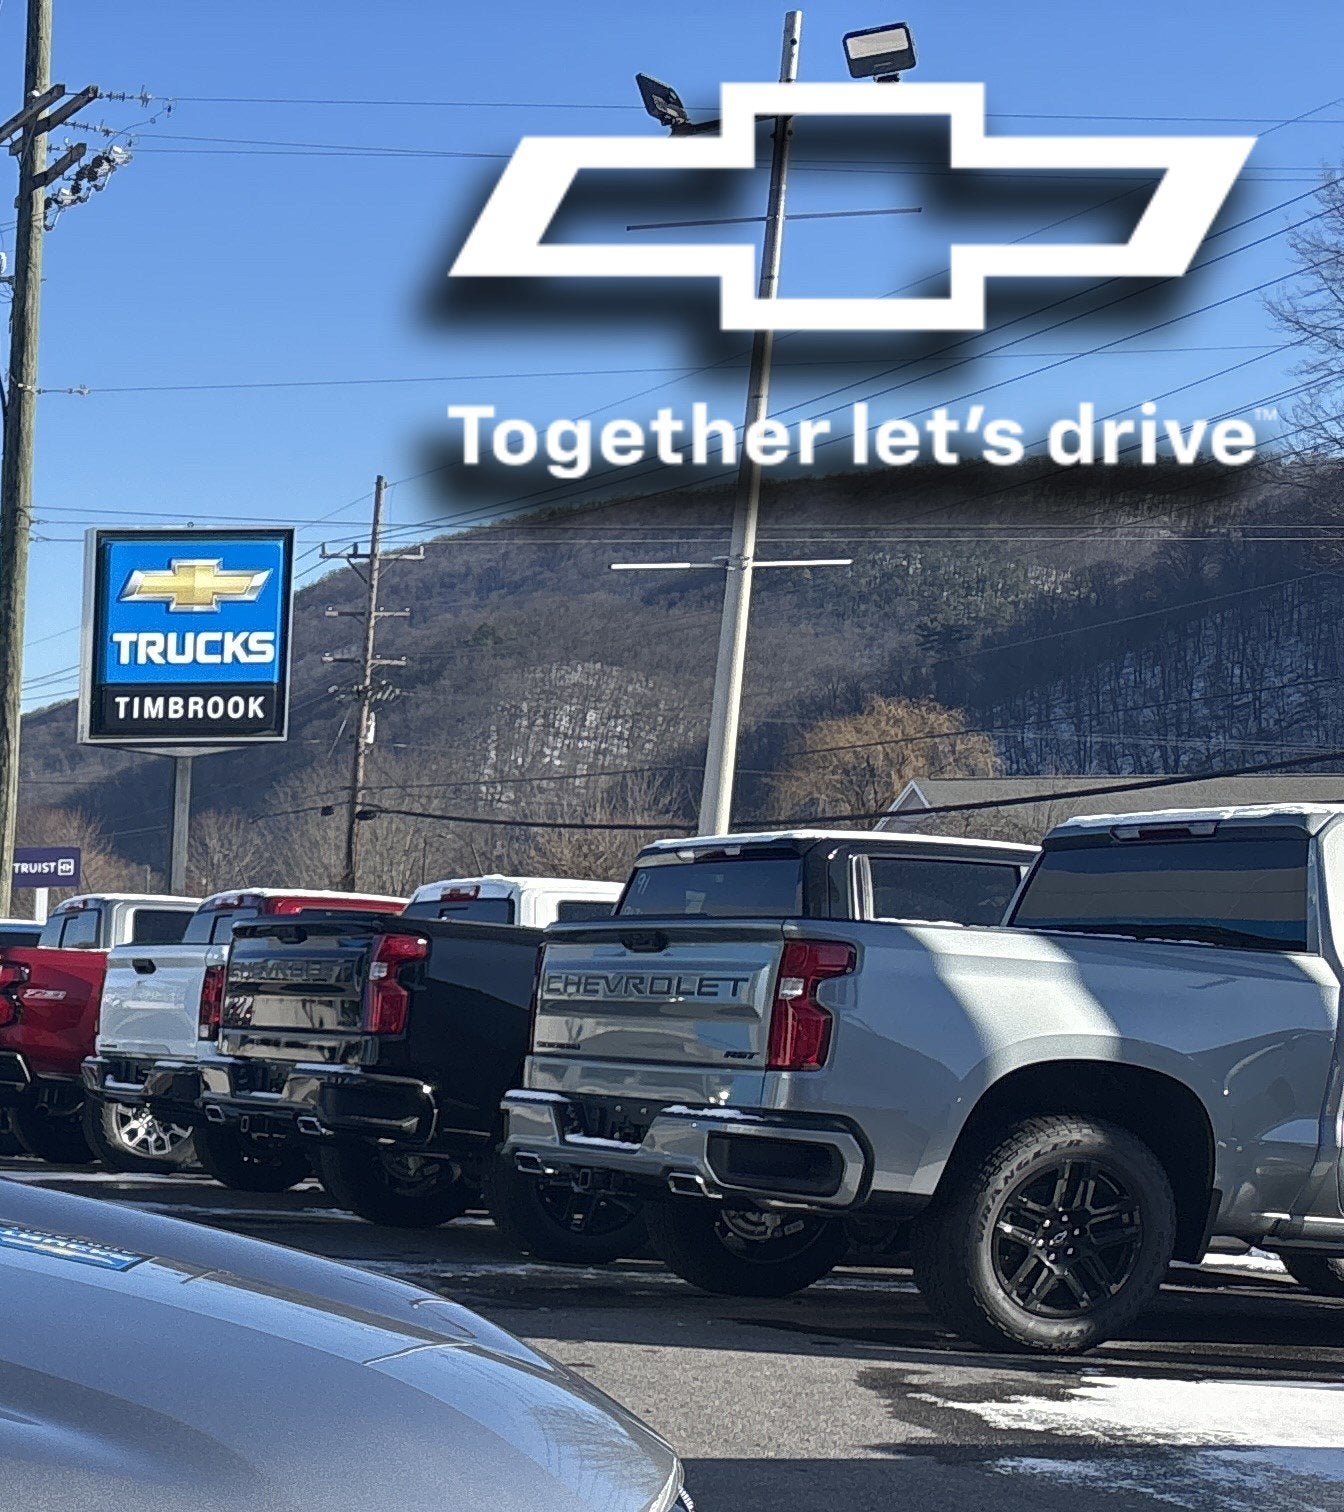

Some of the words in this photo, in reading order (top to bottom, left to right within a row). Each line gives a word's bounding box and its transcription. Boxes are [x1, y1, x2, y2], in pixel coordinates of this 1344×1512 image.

[112, 631, 275, 665] TRUCKS
[115, 695, 265, 719] TIMBROOK
[12, 861, 57, 875] TRUIST
[544, 974, 750, 998] CHEVROLET
